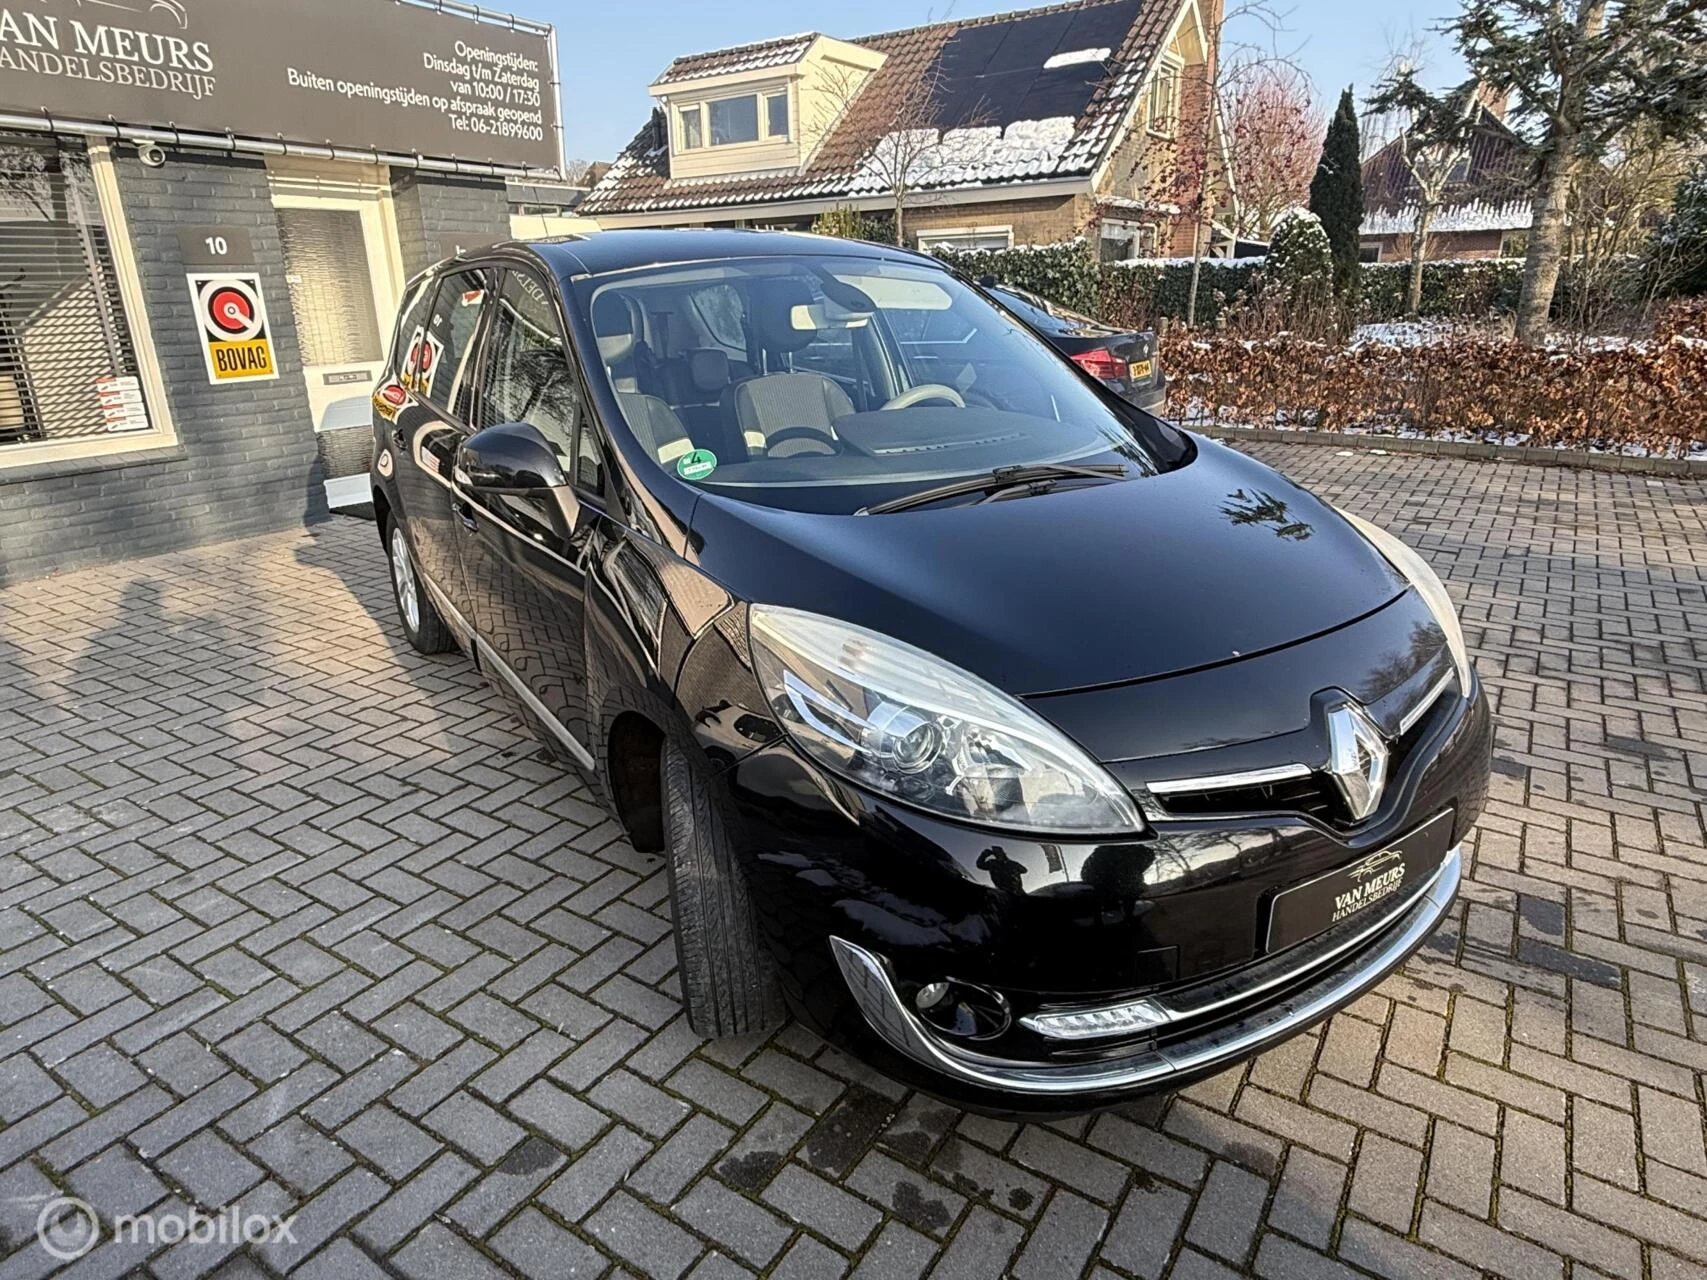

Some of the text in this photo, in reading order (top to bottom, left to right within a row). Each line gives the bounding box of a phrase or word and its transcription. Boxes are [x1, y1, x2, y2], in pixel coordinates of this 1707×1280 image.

[69, 20, 214, 73] MEURS
[454, 40, 539, 72] Openingstijden:
[423, 52, 540, 93] Dinsdag t/m Zaterdag
[287, 67, 542, 125] Buiten openingstijden op afspraak geopend
[449, 80, 472, 96] van
[472, 81, 504, 101] 10:00
[512, 89, 541, 107] 17:30
[448, 113, 543, 141] Tel: 06-21899600
[205, 236, 228, 255] 10
[215, 346, 267, 372] BOVAG
[691, 452, 702, 464] 4
[1335, 862, 1406, 910] VAN MEURS
